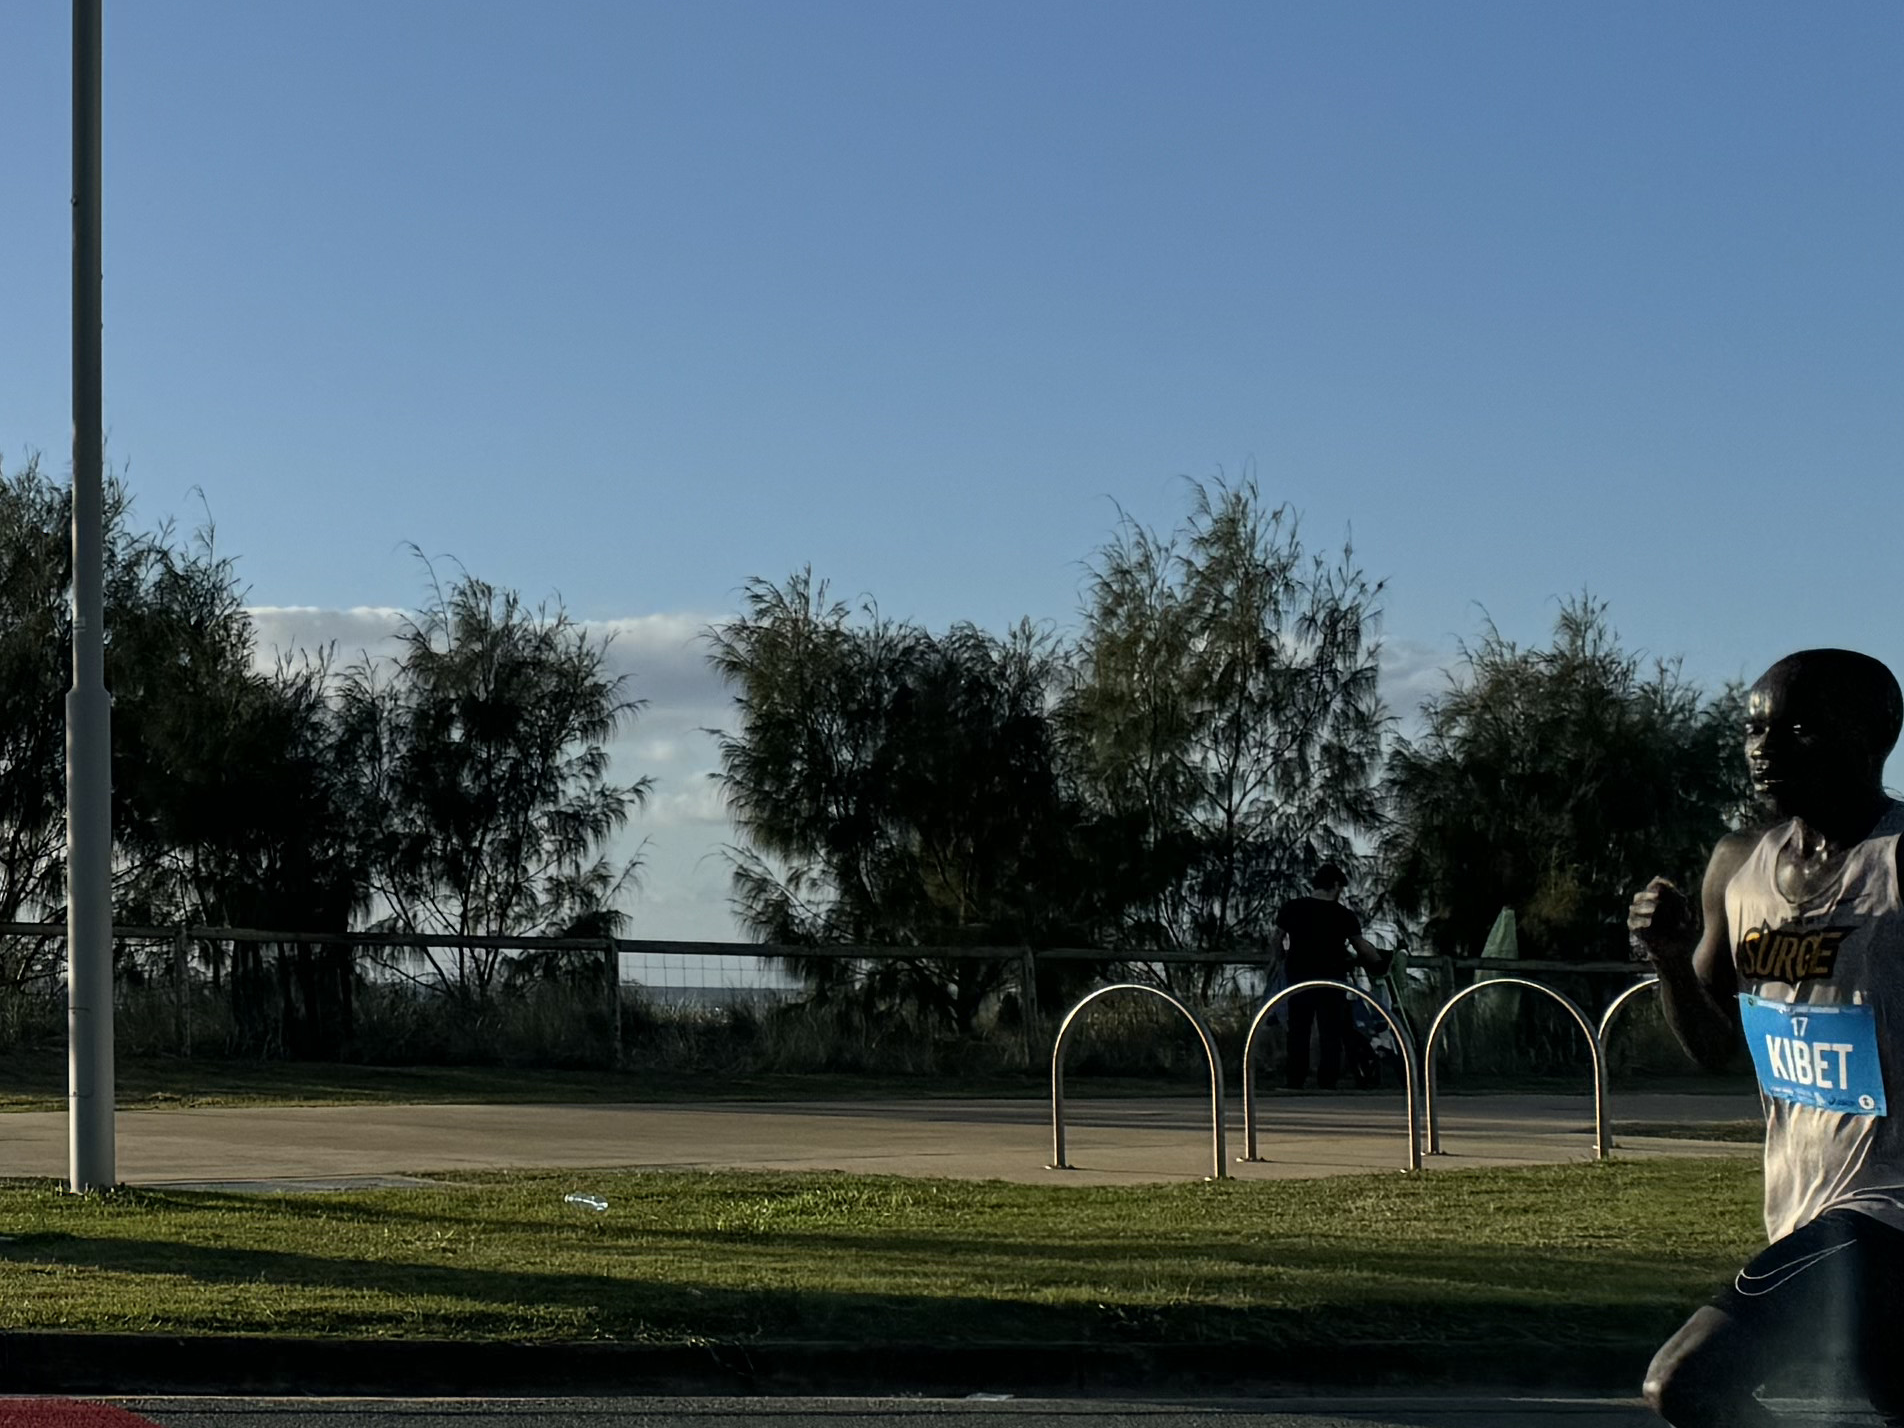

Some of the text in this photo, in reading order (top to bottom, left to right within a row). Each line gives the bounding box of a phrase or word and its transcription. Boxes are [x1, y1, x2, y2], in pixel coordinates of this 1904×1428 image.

[1743, 927, 1844, 982] SURGE
[1791, 1016, 1809, 1037] 17
[1765, 1034, 1854, 1090] KIBET
